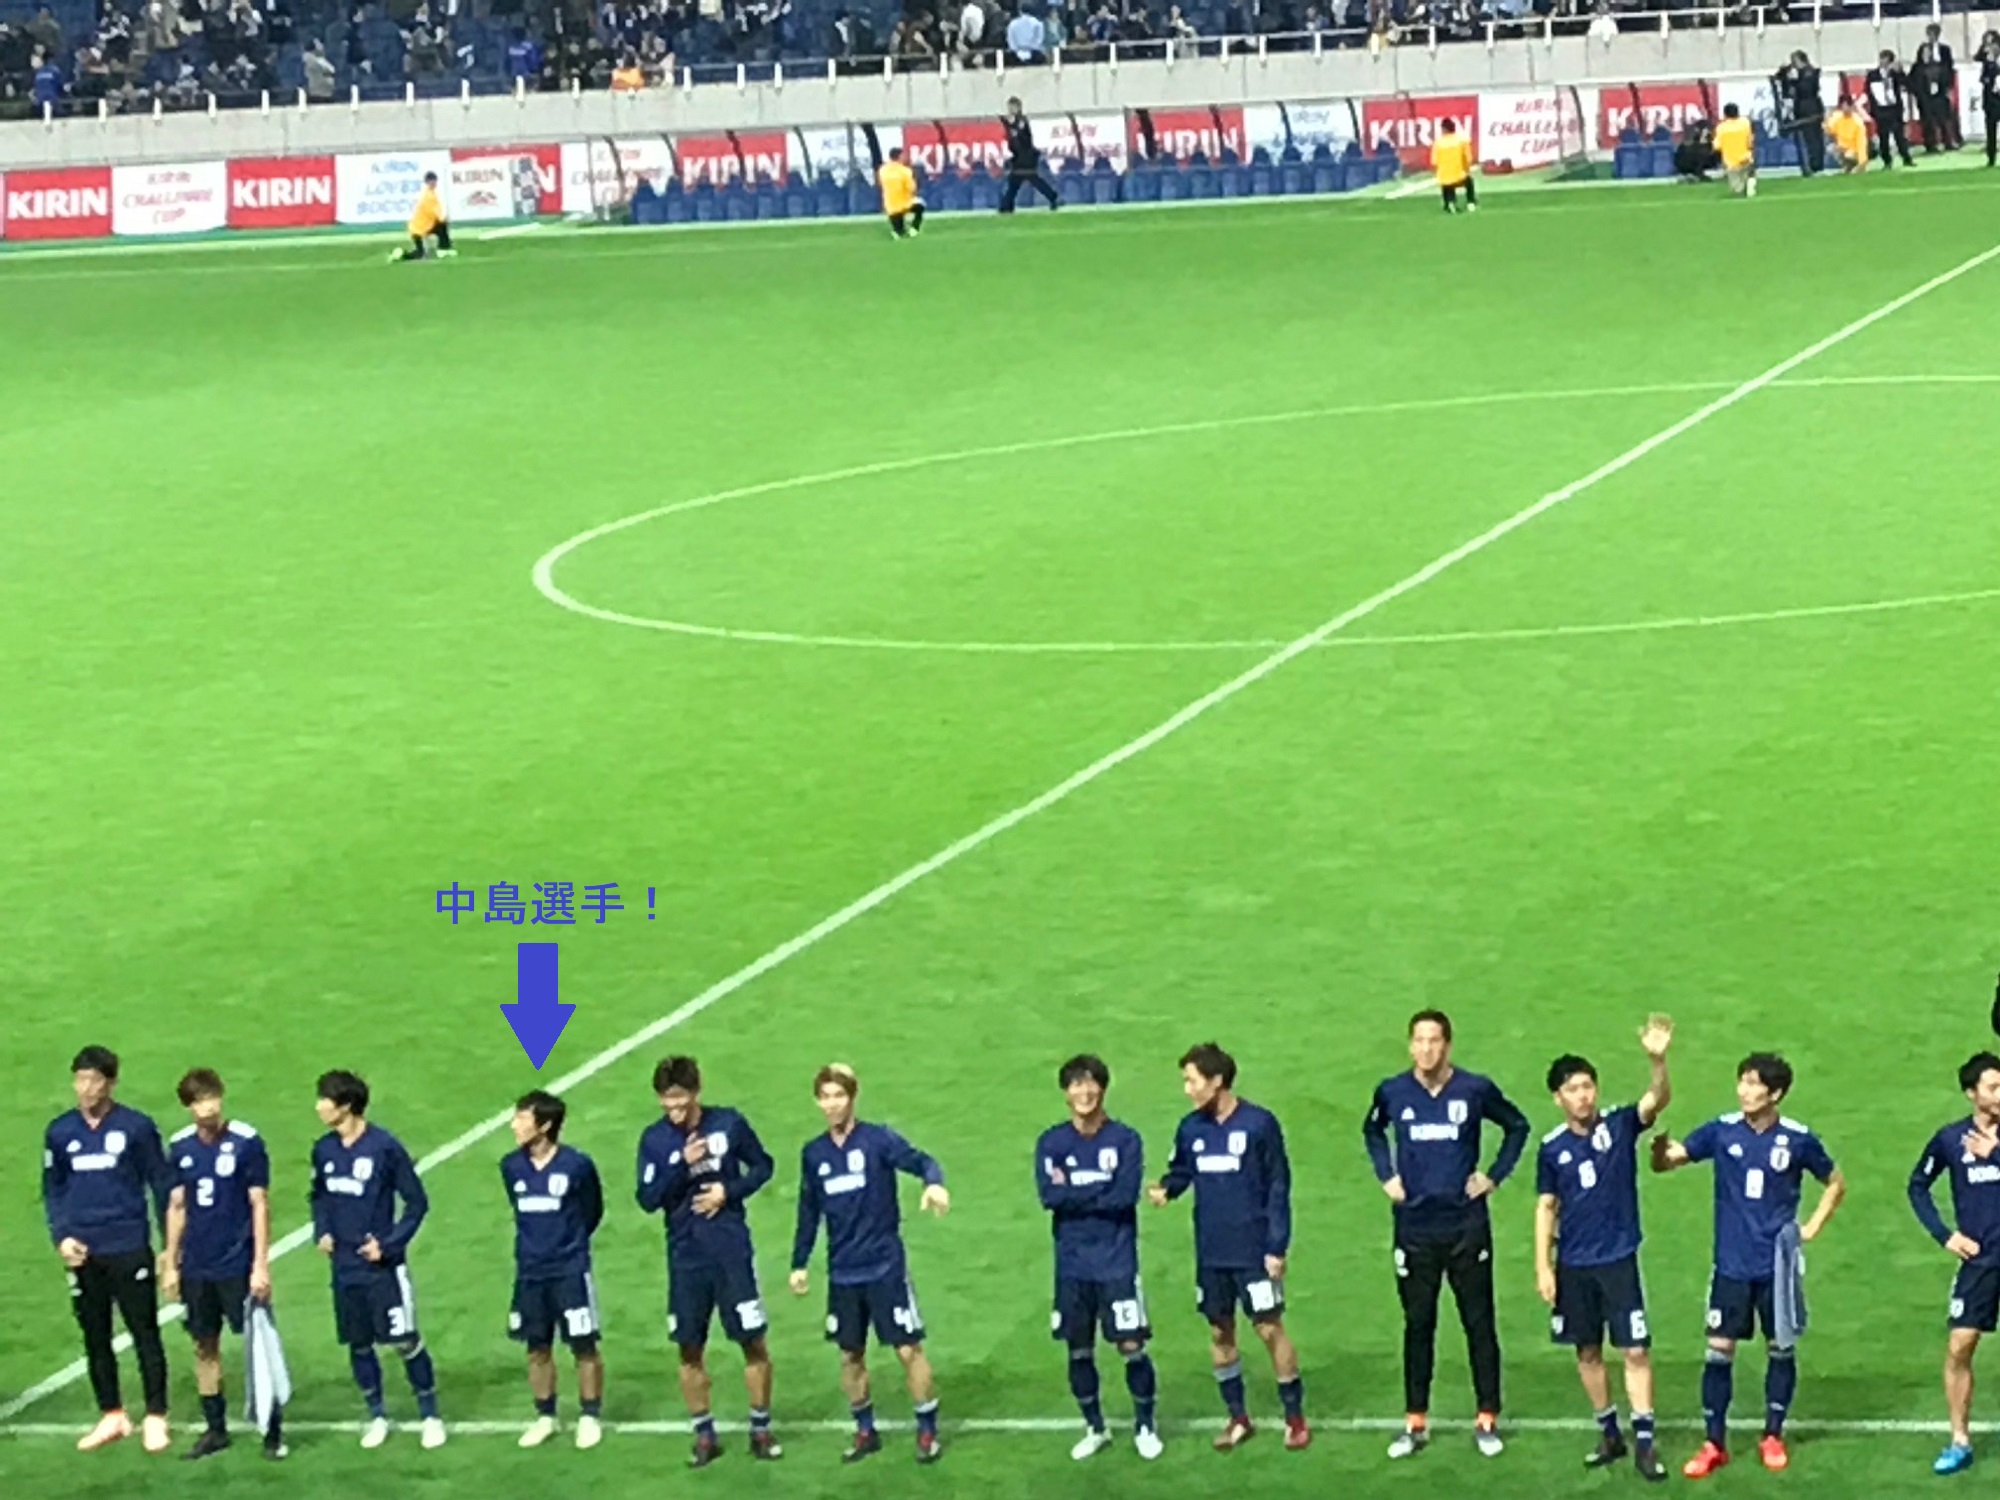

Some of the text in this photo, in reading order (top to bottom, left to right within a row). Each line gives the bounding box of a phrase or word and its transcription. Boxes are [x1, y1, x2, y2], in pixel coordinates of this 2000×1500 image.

[1370, 114, 1472, 150] KIRIN
[909, 140, 1008, 174] KIRIN
[8, 187, 107, 220] KIRIN
[232, 176, 331, 208] KIRIN
[197, 1177, 214, 1206] 2
[894, 1307, 914, 1334] 4
